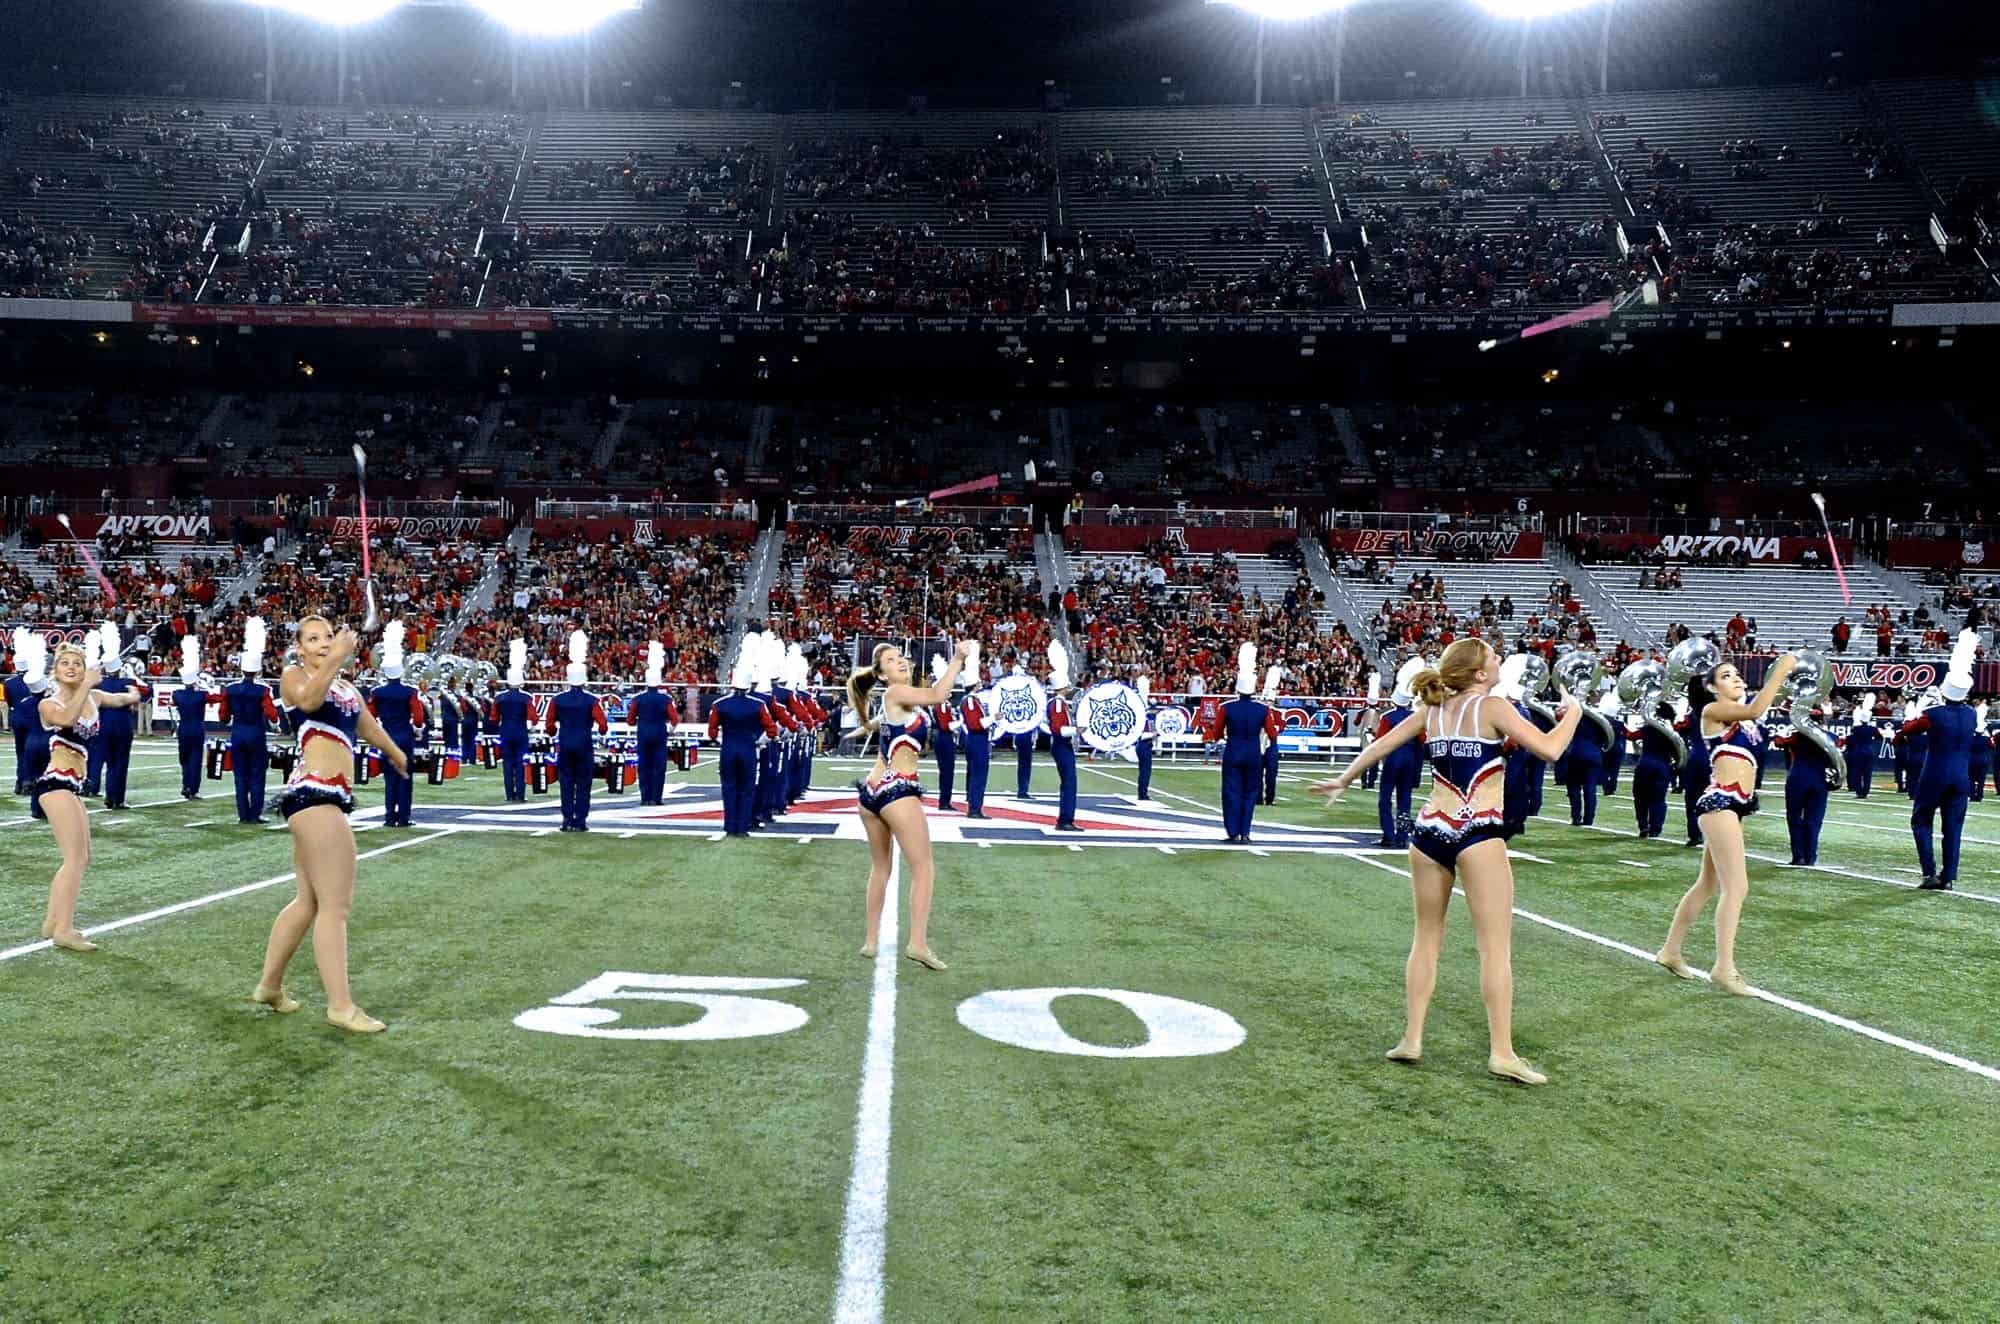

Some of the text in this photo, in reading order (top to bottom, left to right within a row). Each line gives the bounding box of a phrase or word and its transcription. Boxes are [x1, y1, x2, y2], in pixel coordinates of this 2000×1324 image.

[1517, 499, 1528, 512] 6
[96, 515, 211, 537] ARIZONA
[399, 517, 481, 538] DOWN
[1650, 535, 1781, 560] ARIZONA
[1451, 741, 1482, 758] CATS
